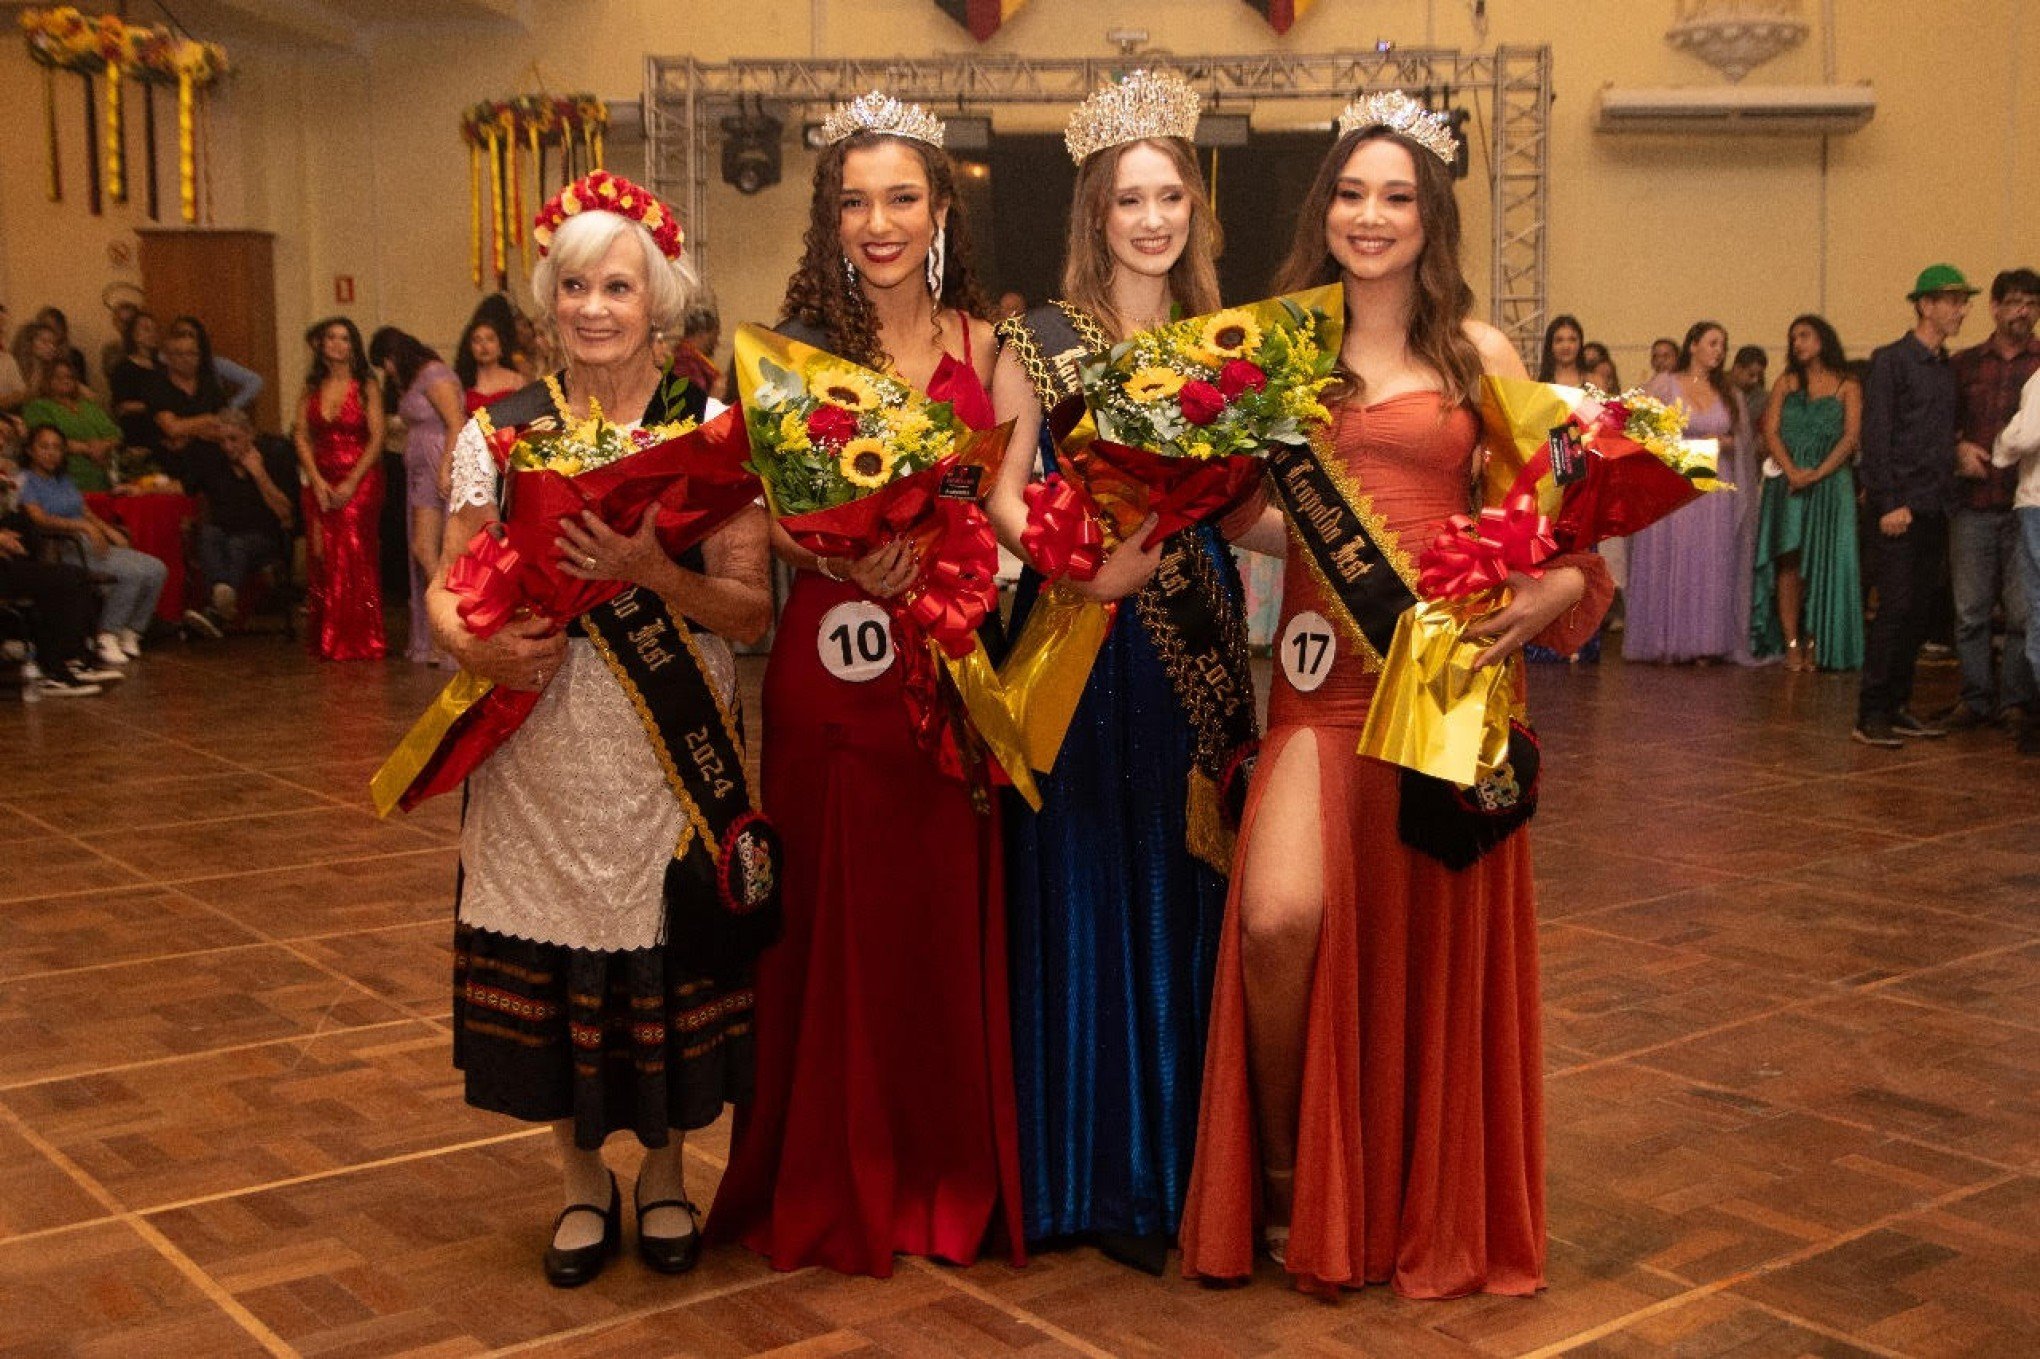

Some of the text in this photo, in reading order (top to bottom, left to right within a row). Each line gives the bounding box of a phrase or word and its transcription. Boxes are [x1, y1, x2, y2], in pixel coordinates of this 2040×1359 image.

[1330, 534, 1375, 584] Fest
[828, 620, 887, 667] 10
[1292, 631, 1330, 675] 17
[1195, 646, 1241, 717] 2024
[627, 617, 677, 672] Fest
[685, 725, 734, 799] 2024
